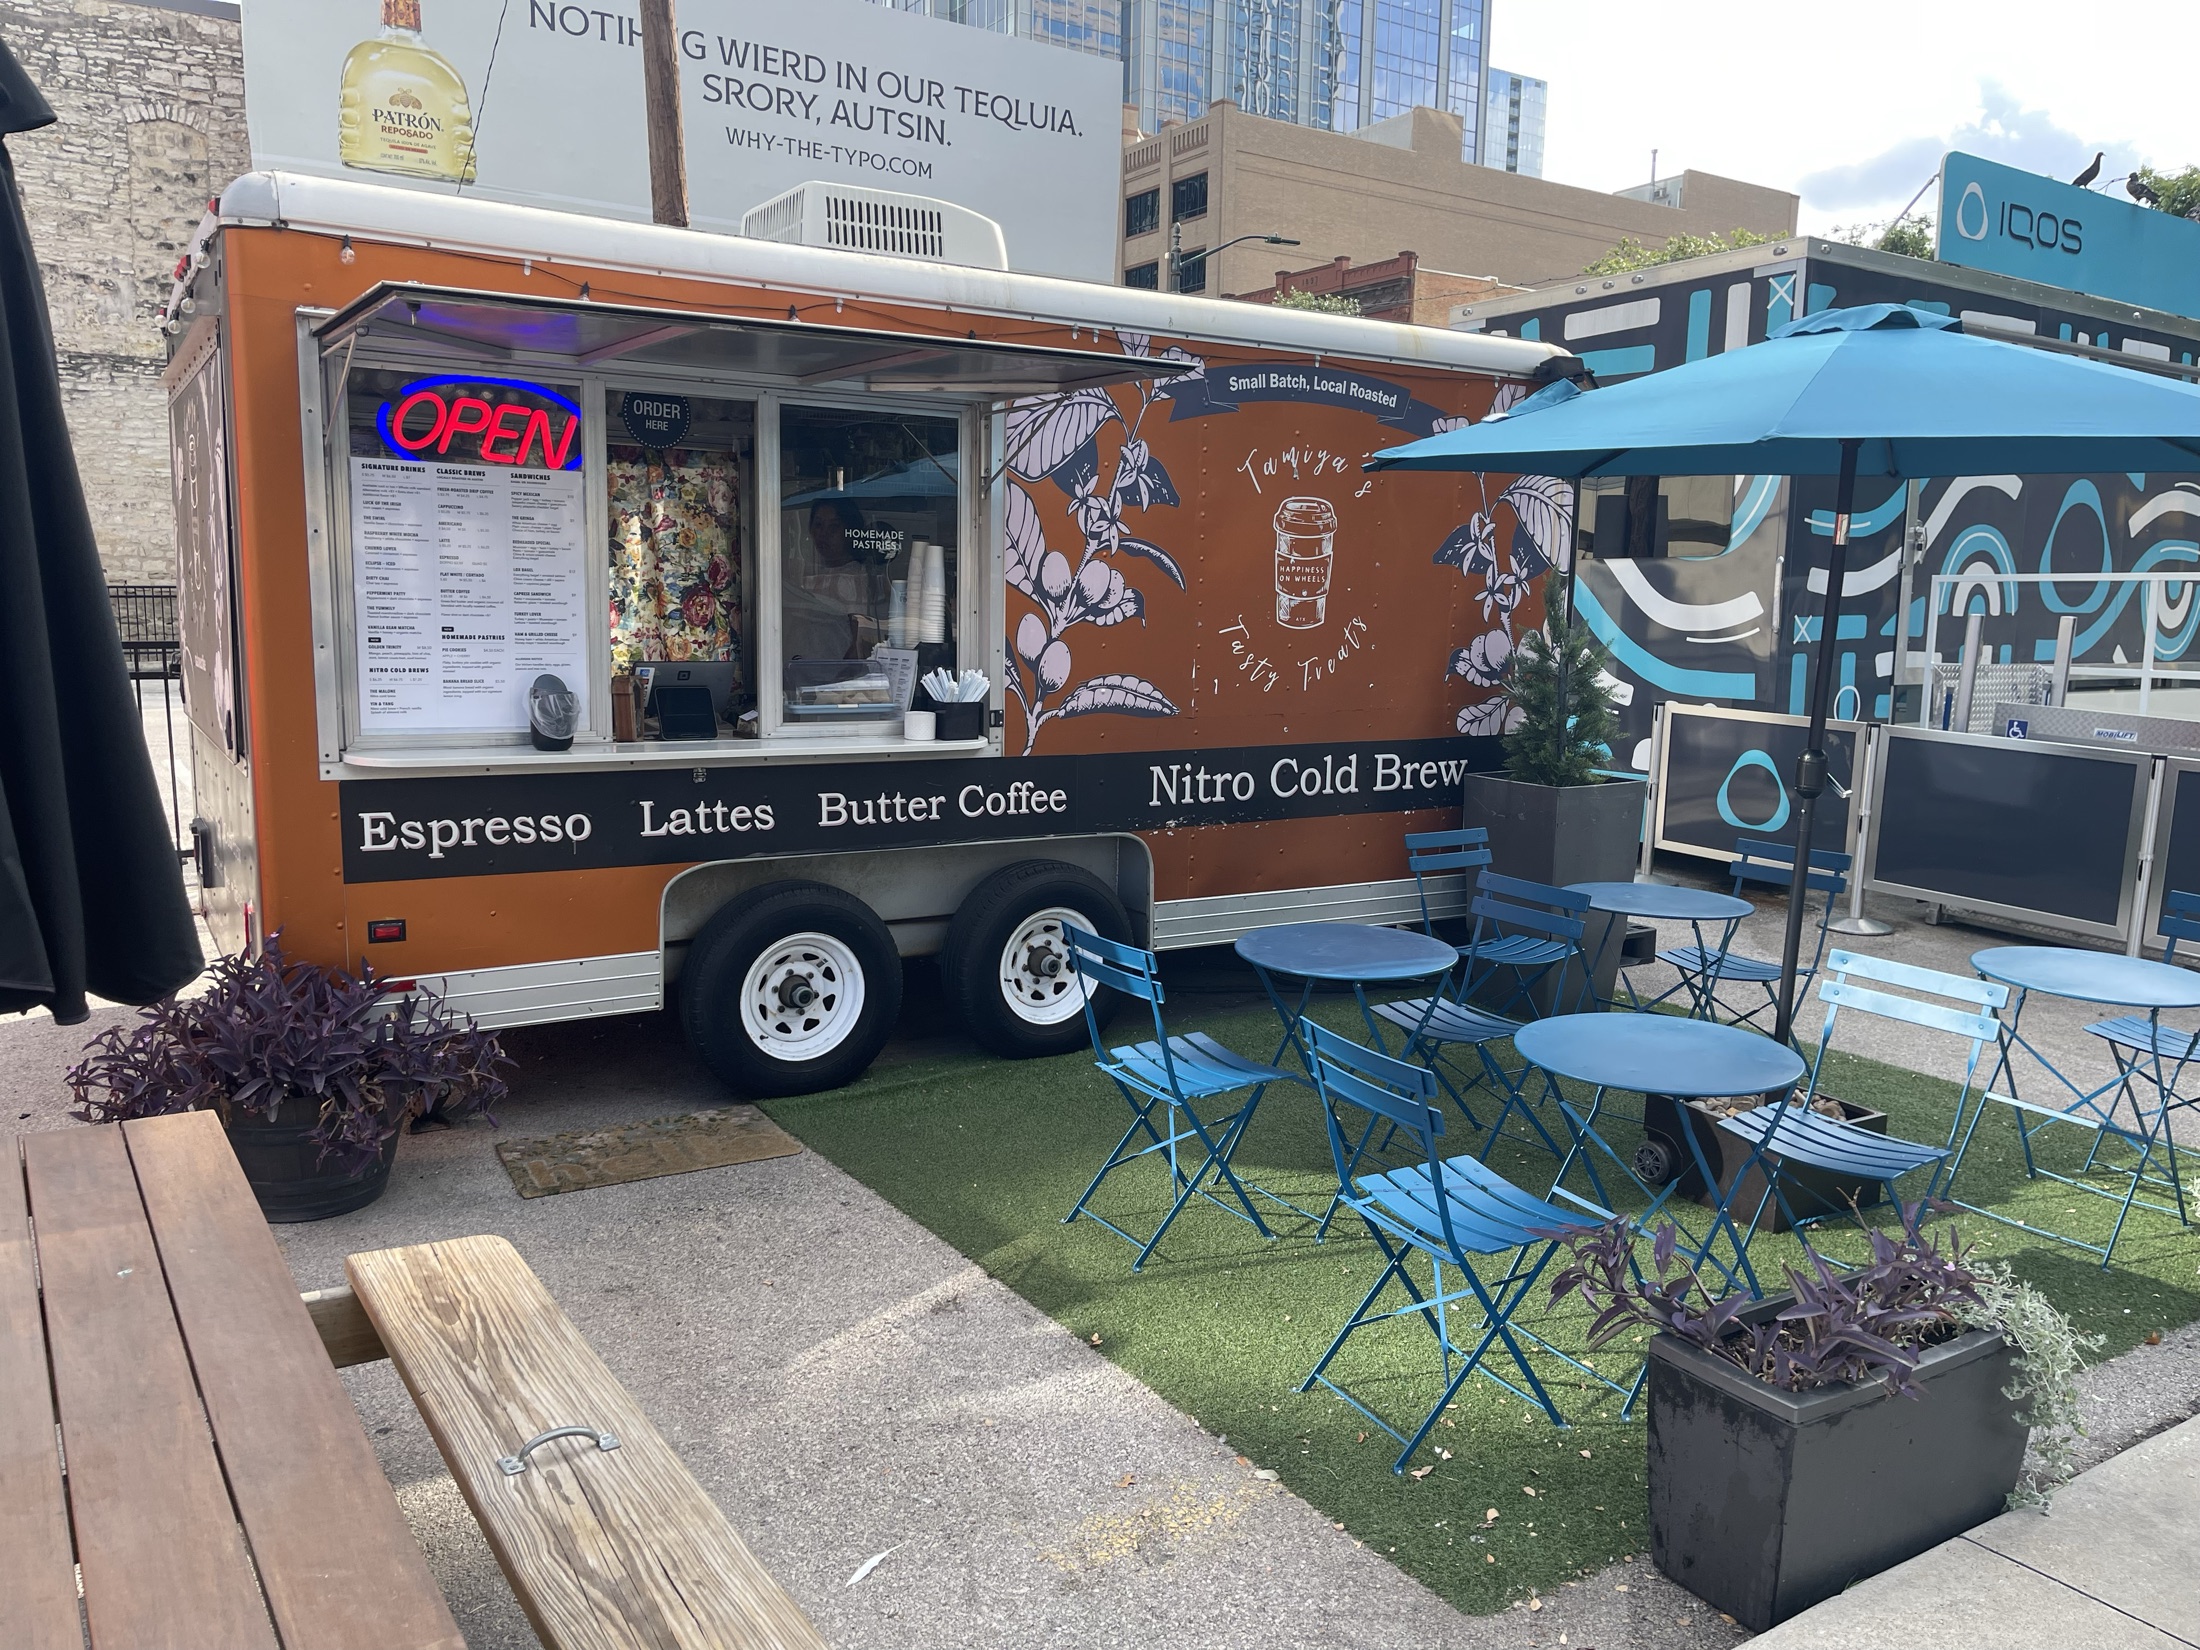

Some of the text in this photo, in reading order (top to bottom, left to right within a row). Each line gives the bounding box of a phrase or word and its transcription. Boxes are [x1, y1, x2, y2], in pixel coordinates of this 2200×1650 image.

[529, 0, 1083, 137] NOTIHG WIERD IN OUR TEQLUIA.
[702, 73, 952, 147] SRORY, AUTSIN.
[381, 125, 433, 140] REPOSADO
[725, 126, 933, 179] WHY-THE-TYPO.COM
[1999, 201, 2083, 255] IQOS
[1229, 373, 1397, 408] Small Batch, Local Roasted
[633, 399, 681, 419] ORDER
[392, 391, 578, 470] OPEN
[645, 419, 669, 431] HERE
[361, 463, 426, 473] SIGNATURE DRINKS
[436, 468, 486, 477] CLASSIC BREWS
[510, 473, 550, 481] SANDWICHES
[844, 529, 904, 540] HOMEMADE
[852, 540, 897, 550] PASTRIES
[1280, 566, 1324, 574] HAPPINESS
[1295, 575, 1325, 583] WHEELS
[359, 752, 1468, 859] Espresso Lattes Butter Coffee Nitro Cold Brew
